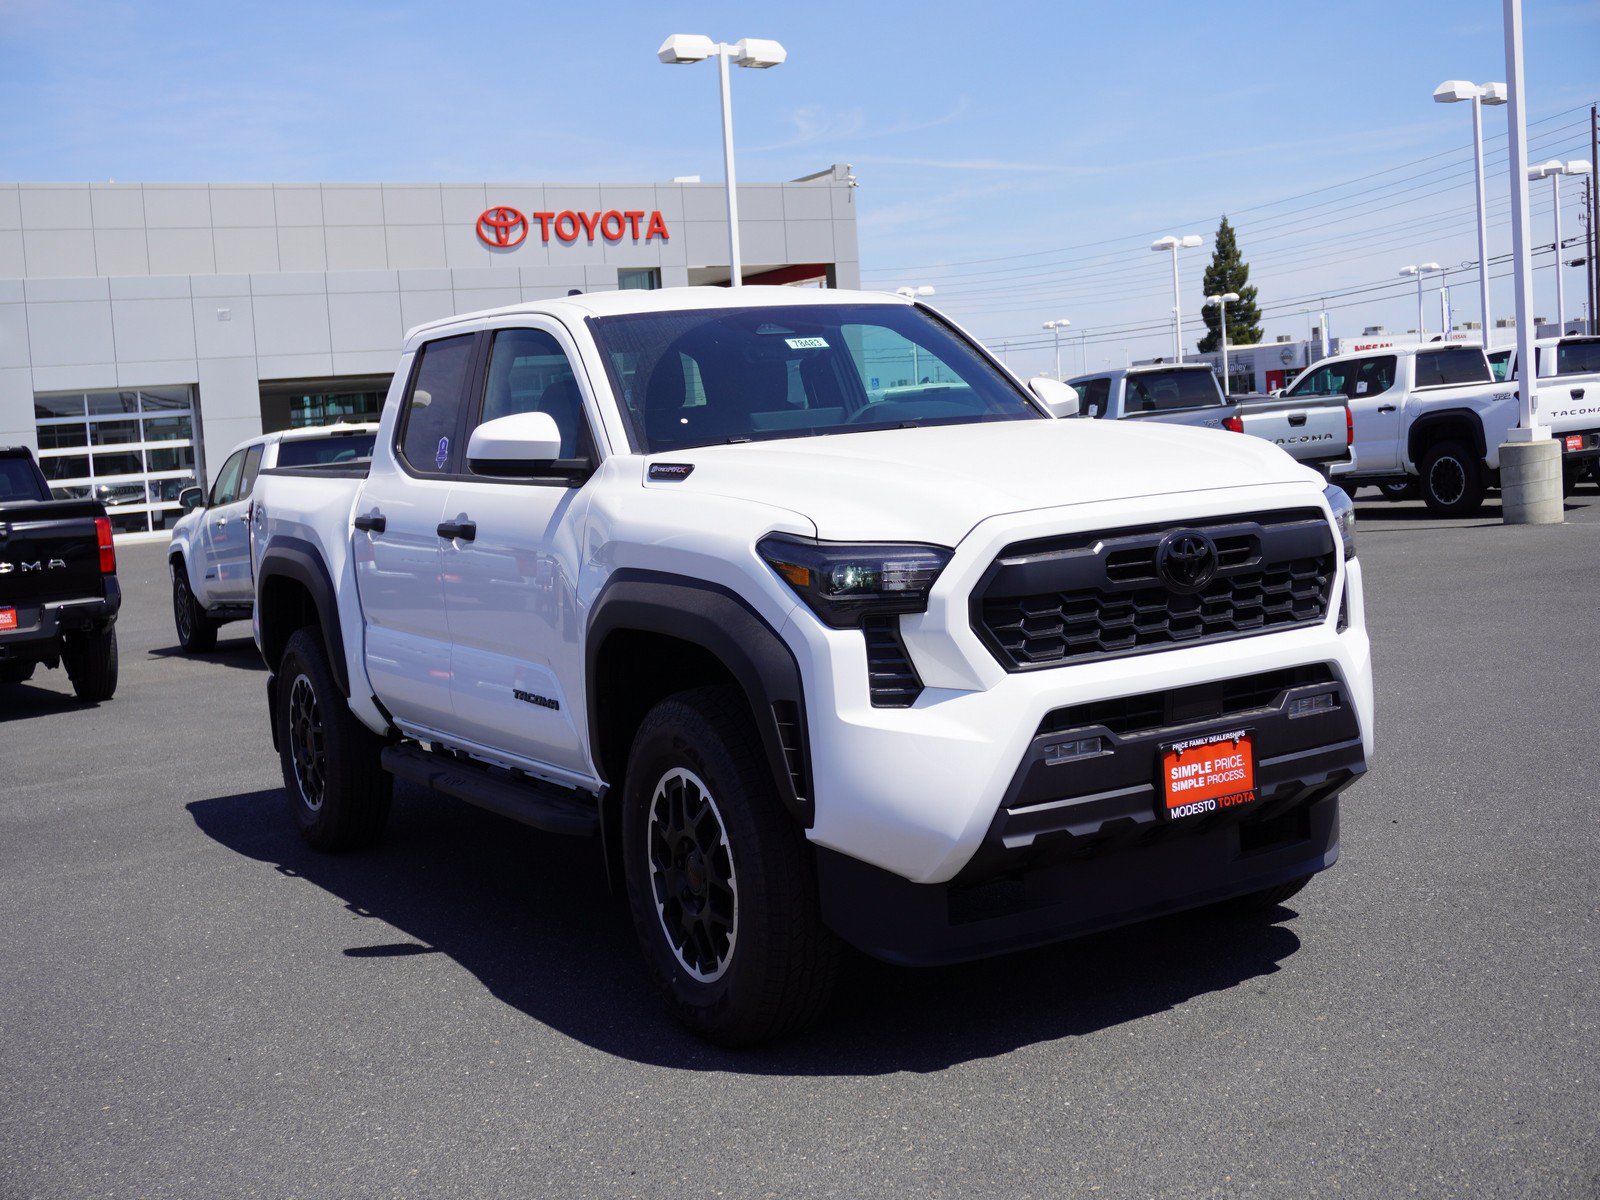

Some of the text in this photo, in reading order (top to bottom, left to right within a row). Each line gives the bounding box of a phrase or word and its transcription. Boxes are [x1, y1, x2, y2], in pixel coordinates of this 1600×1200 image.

[533, 210, 670, 241] TOYOTA
[792, 339, 822, 348] 78483
[1270, 433, 1333, 445] ACOMA
[1172, 730, 1246, 751] PRICE FAMILY DEALERSHIPS
[1171, 754, 1246, 780] SIMPLE PRICE.
[1171, 769, 1246, 792] SIMPLE PROCESS.
[1171, 791, 1255, 819] MODESTO TOYOTA
